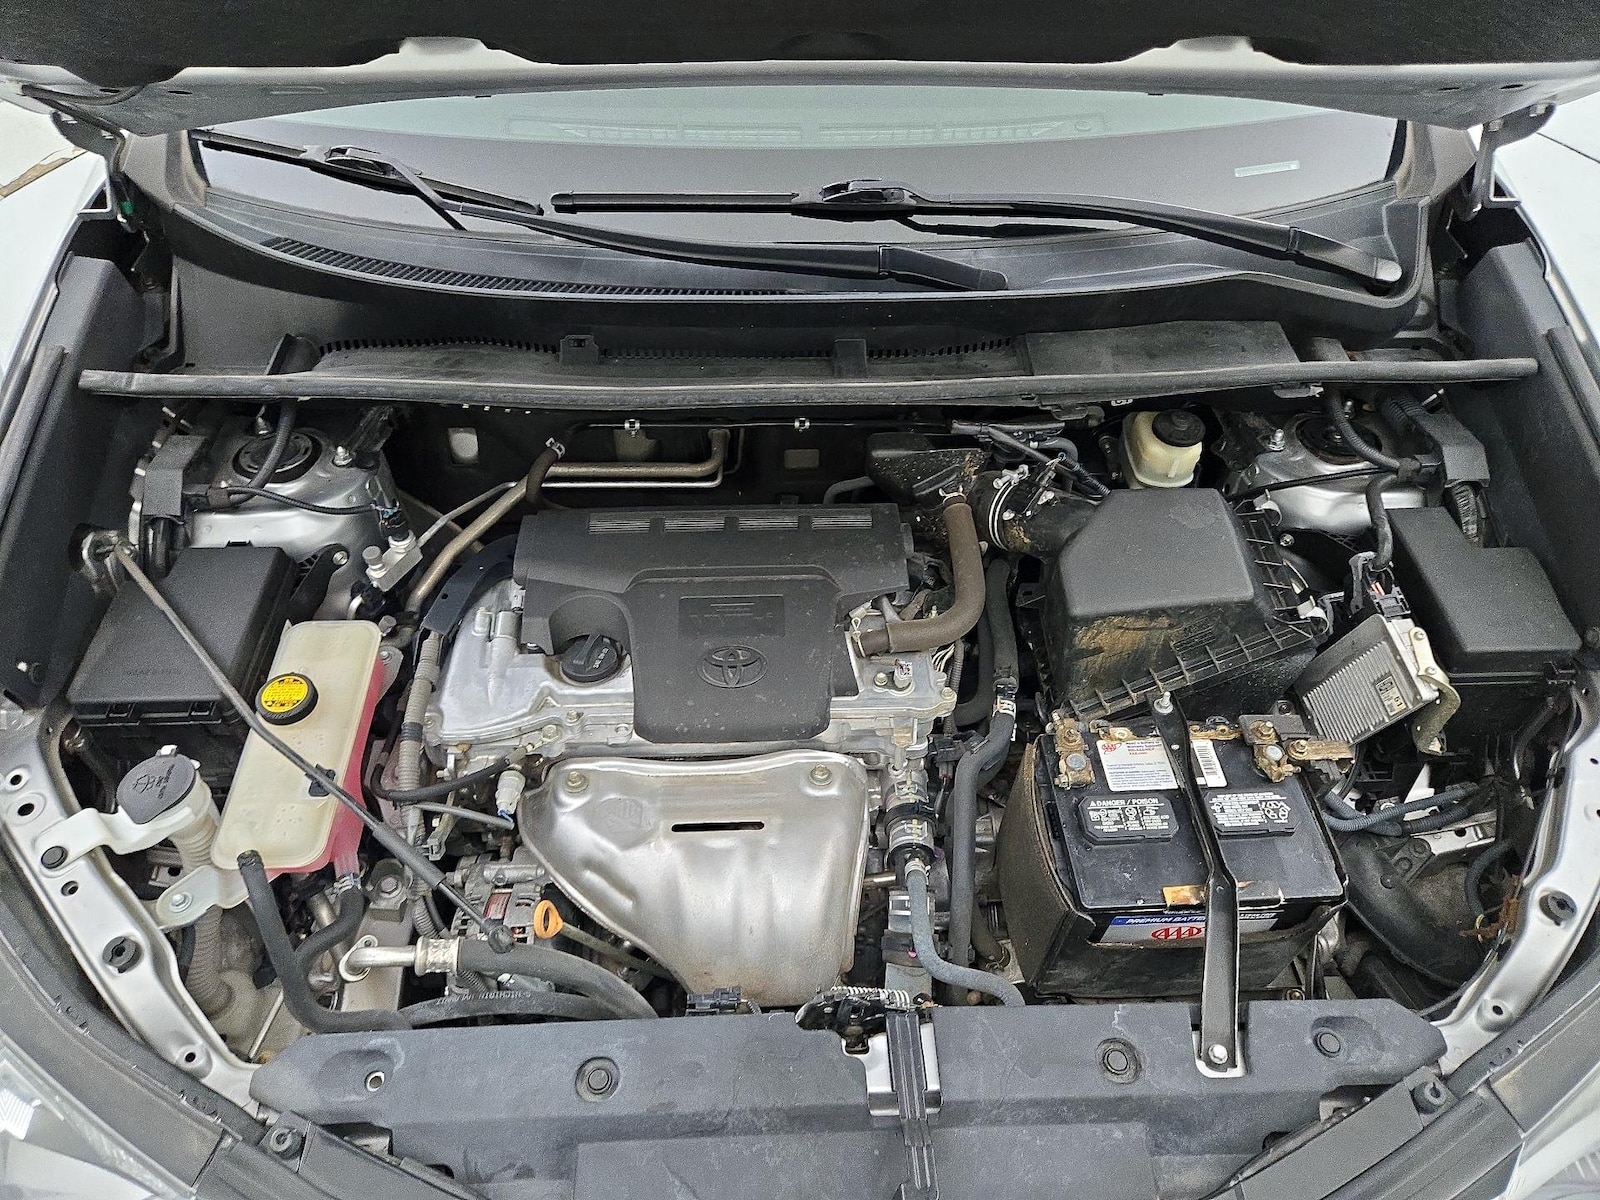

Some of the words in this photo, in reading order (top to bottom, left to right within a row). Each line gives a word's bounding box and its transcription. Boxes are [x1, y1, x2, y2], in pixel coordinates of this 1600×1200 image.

[1096, 799, 1125, 807] DANGER
[1132, 797, 1159, 805] POISON
[1151, 926, 1202, 940] AAA
